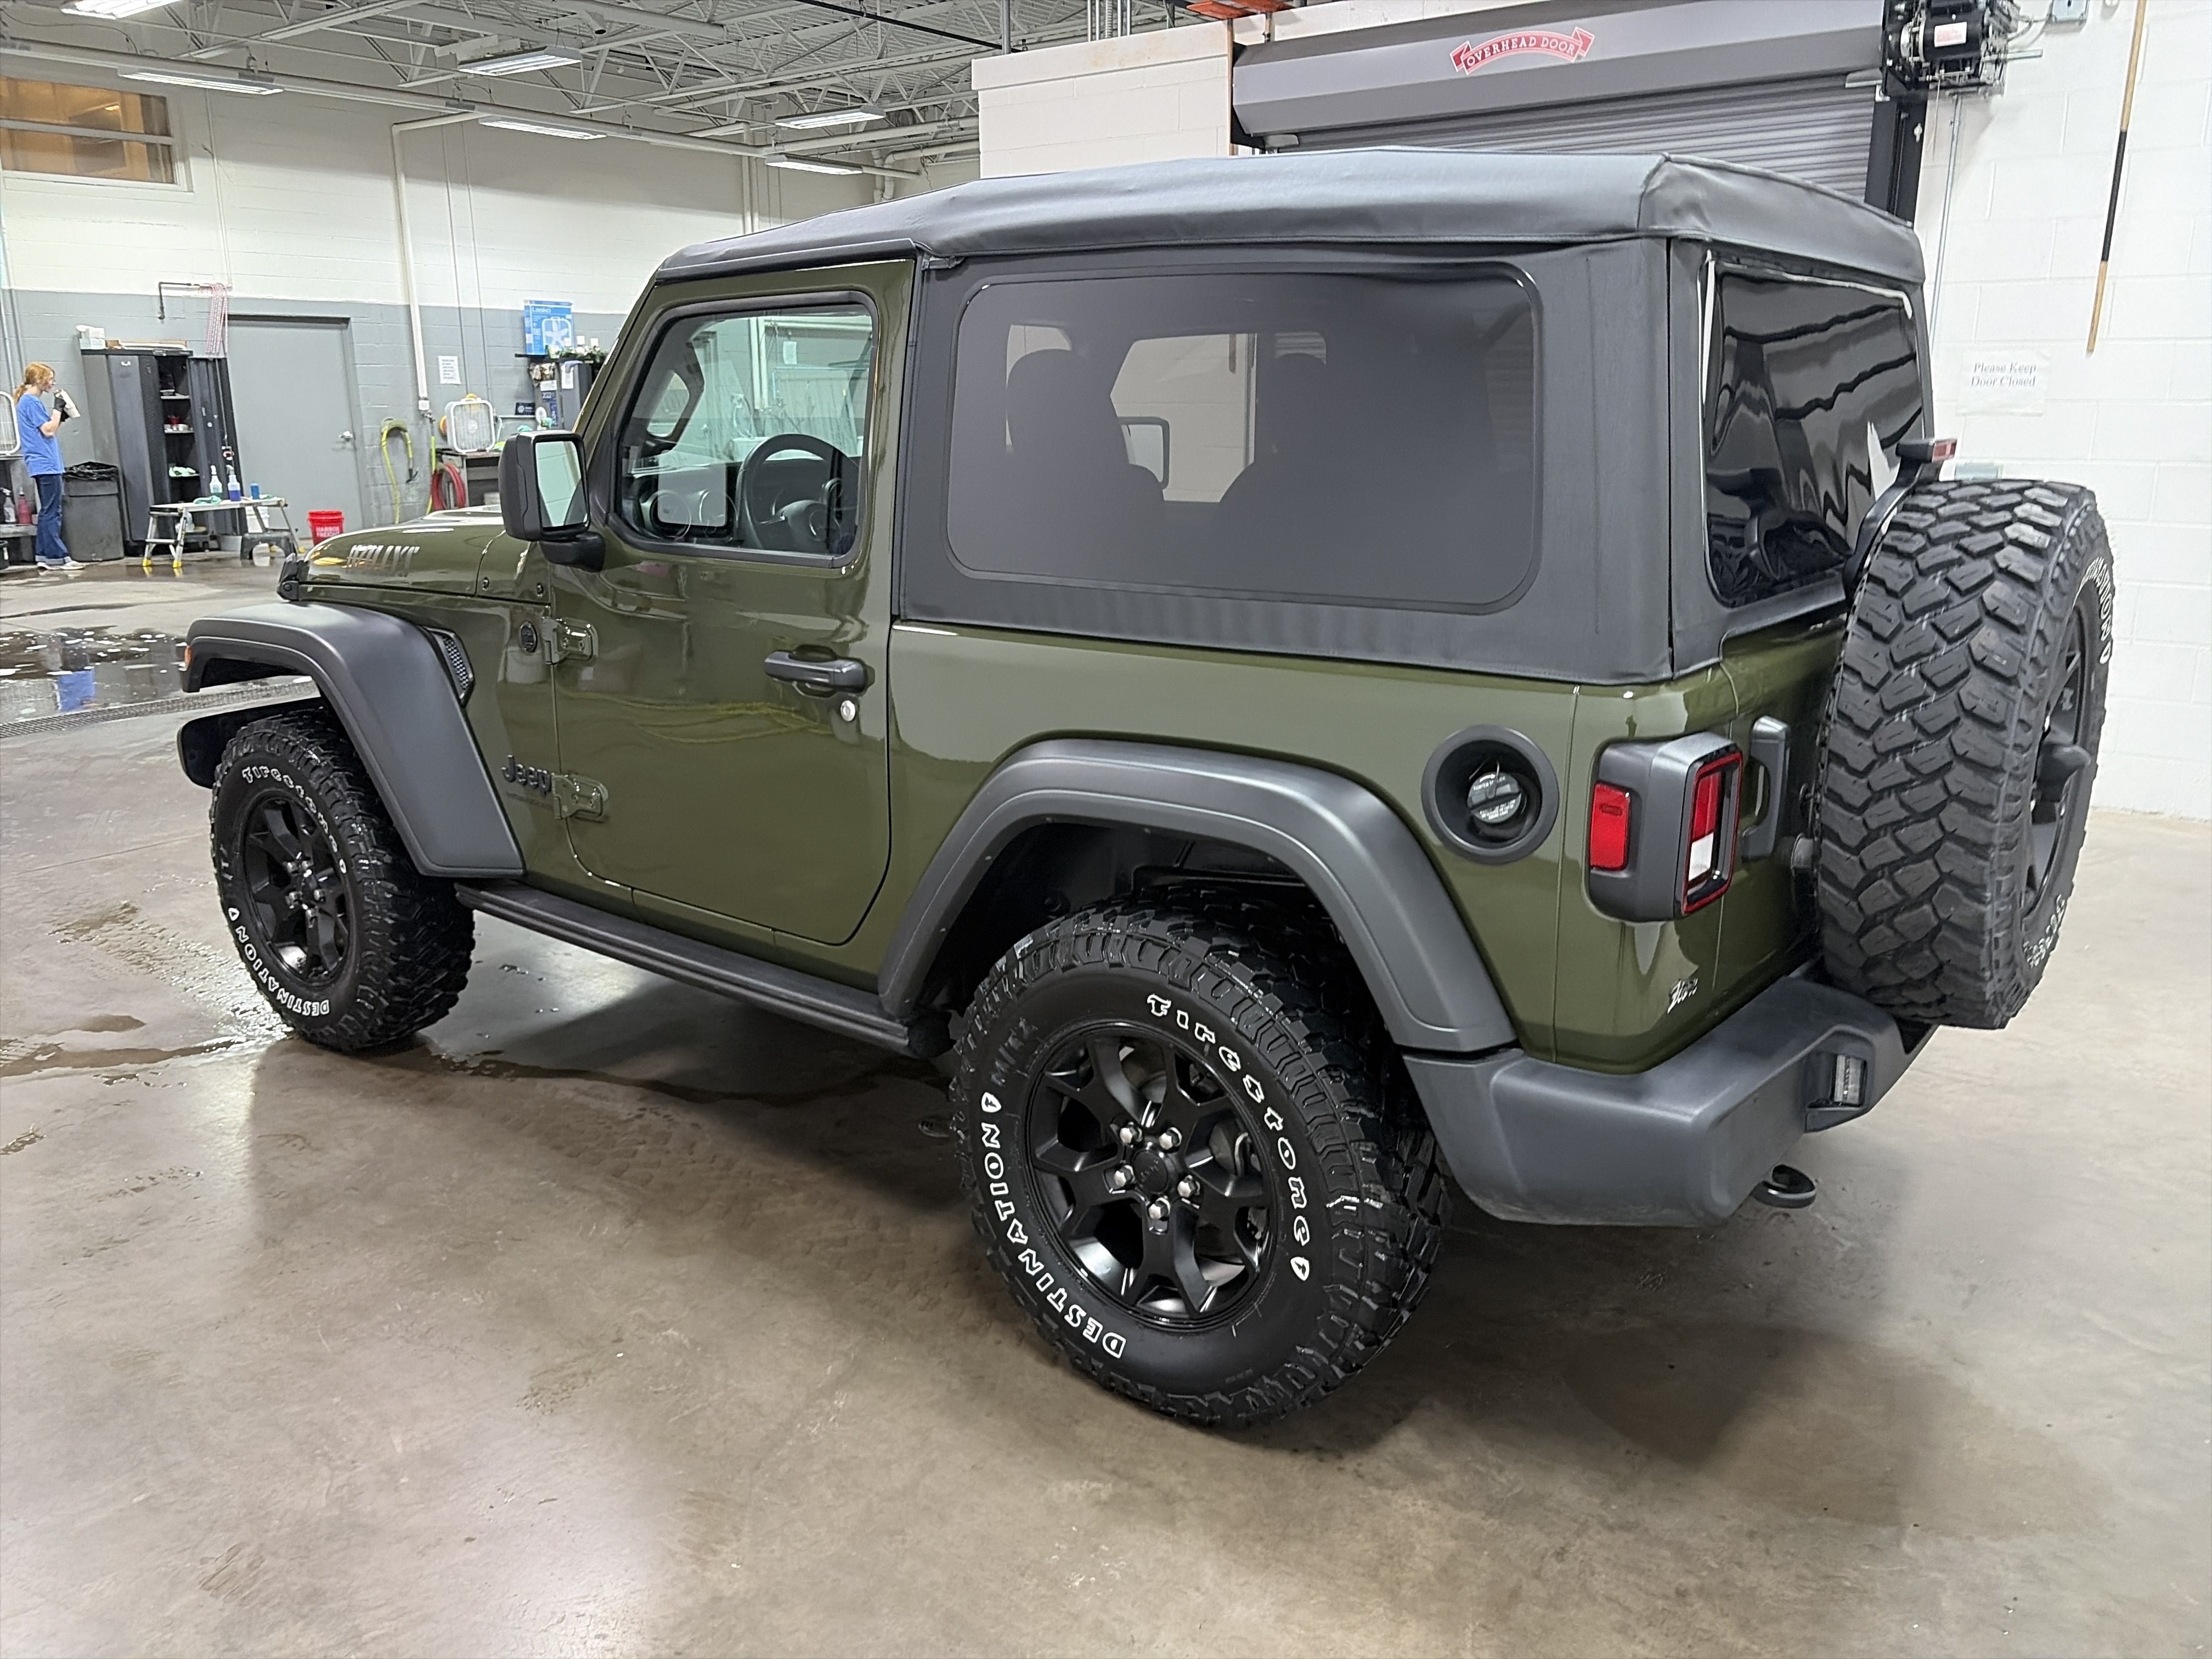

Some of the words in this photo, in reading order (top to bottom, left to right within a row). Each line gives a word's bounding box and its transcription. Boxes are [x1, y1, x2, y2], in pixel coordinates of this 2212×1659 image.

[1466, 37, 1537, 66] OVERHEAD
[1541, 37, 1575, 55] DOOR
[1972, 375, 1997, 386] Door
[2000, 375, 2036, 386] Closed
[1974, 362, 2006, 373] Please
[2010, 362, 2036, 375] Keep
[501, 754, 551, 797] Jeep
[235, 926, 330, 1017] DESTINATION
[981, 1122, 1126, 1359] DESTINATION
